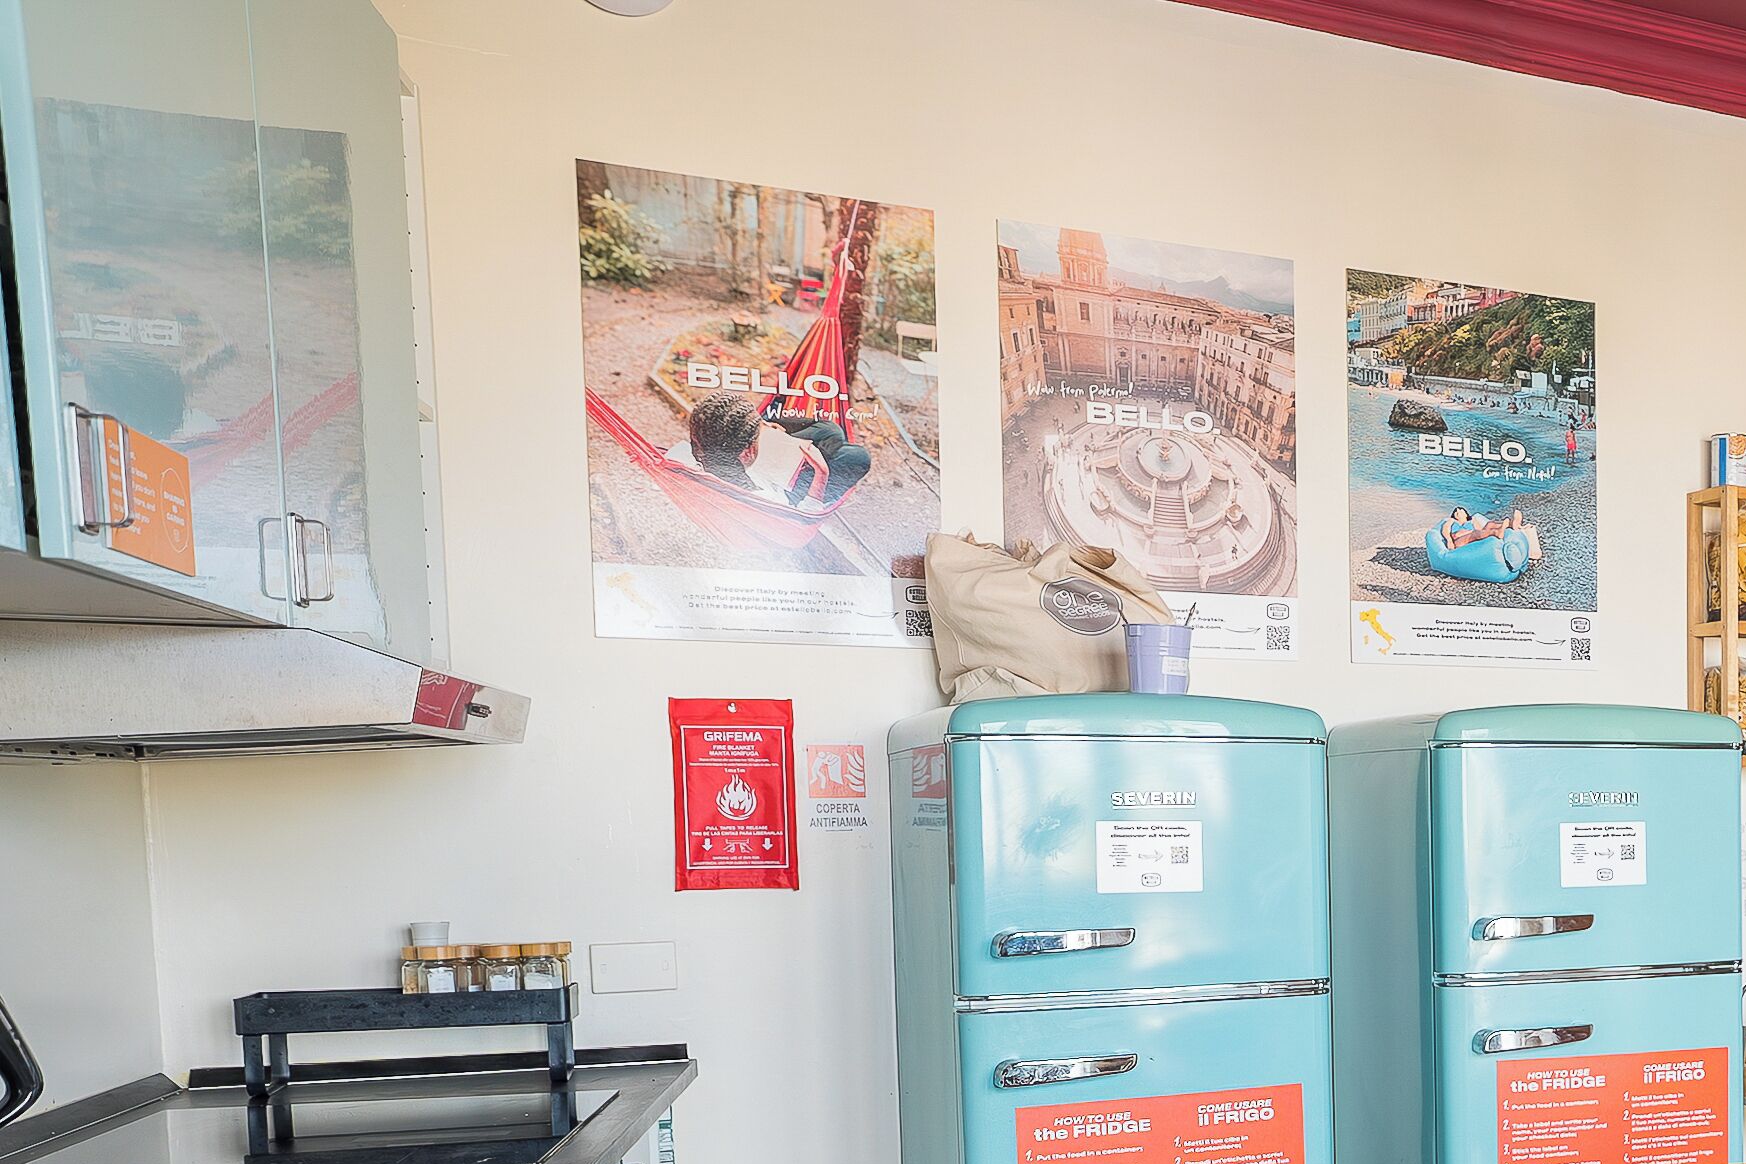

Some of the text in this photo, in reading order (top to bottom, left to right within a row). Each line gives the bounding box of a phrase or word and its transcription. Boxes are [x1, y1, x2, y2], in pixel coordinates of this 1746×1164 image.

[687, 362, 848, 401] BELLO.
[1060, 381, 1085, 398] from
[812, 403, 840, 422] from
[1086, 400, 1221, 435] BELLO.
[1419, 434, 1533, 464] BELLO.
[1504, 464, 1525, 481] from
[703, 732, 763, 742] GRIFEMA
[1111, 791, 1197, 806] SEVERIN
[1568, 791, 1639, 804] SEVERIN
[816, 803, 860, 814] COPERTA
[810, 816, 868, 828] ANTIFIAMMA
[1527, 1068, 1591, 1080] HOW TO USE
[1643, 1060, 1704, 1072] COME USARE
[1510, 1075, 1606, 1092] the FRIDGE
[1655, 1069, 1705, 1083] FRIGO
[1197, 1098, 1273, 1114] COME USARE
[1054, 1111, 1132, 1127] HOW TO USE
[1213, 1107, 1275, 1125] FRIGO
[1034, 1118, 1152, 1142] the FRIDGE
